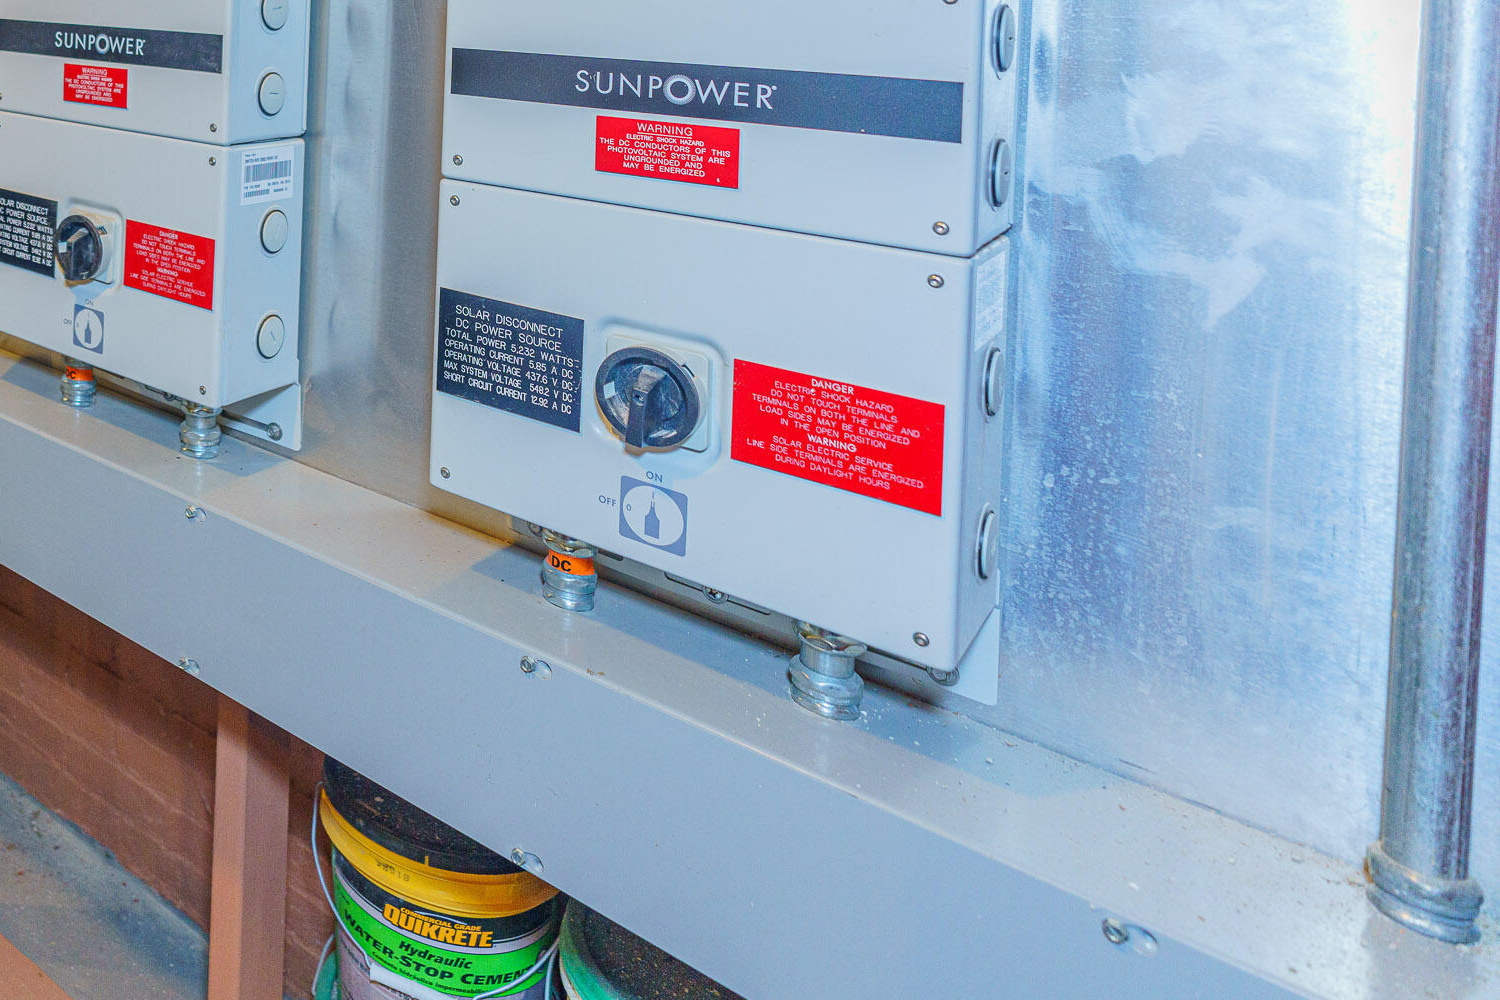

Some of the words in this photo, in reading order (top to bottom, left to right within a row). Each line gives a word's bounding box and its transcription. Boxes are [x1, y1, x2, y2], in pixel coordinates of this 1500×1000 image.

[55, 31, 145, 55] SUNPOWER
[575, 69, 775, 110] SUNPOWER
[626, 134, 653, 142] ELECTRIC
[657, 136, 677, 145] SHOCK
[637, 123, 693, 136] WARNING
[600, 137, 614, 145] THE
[619, 139, 630, 147] DC
[635, 141, 690, 154] CONDUCTORS
[711, 149, 731, 157] THIS
[607, 146, 666, 158] PHOTOVOLTAIC
[671, 152, 703, 162] SYSTEM
[708, 156, 725, 165] ARE
[624, 155, 680, 167] UNGROUNDED
[685, 162, 703, 170] AND
[659, 166, 705, 178] ENERGIZED
[6, 208, 24, 219] POWER
[455, 318, 469, 329] DC
[475, 322, 512, 340] POWER
[518, 333, 562, 352] SOURCE
[456, 305, 490, 321] SOLAR
[496, 314, 563, 338] DISCONNECT
[444, 339, 485, 356] OPERATING
[489, 350, 524, 366] CURRENT
[551, 367, 558, 375] A
[562, 368, 573, 379] DC
[445, 327, 472, 341] TOTAL
[476, 336, 506, 350] POWER
[541, 351, 573, 368] WATTS
[444, 349, 483, 366] OPERATING
[487, 360, 521, 377] VOLTAGE
[525, 371, 548, 384] 437.6
[552, 378, 558, 386] V
[562, 380, 573, 391] DC
[444, 360, 458, 370] MAX
[461, 365, 488, 379] SYSTEM
[491, 372, 522, 388] VOLTAGE
[554, 390, 559, 398] V
[562, 392, 572, 402] DC
[444, 371, 465, 384] SHORT
[468, 378, 493, 392] CIRCUIT
[496, 386, 527, 401] CURRENT
[552, 402, 558, 410] A
[562, 404, 572, 414] DC
[774, 381, 816, 395] ELECTRIC
[821, 391, 851, 403] SHOCK
[856, 399, 894, 413] HAZARD
[812, 378, 854, 395] DANGER
[752, 393, 799, 411] TERMINALS
[804, 405, 817, 414] ON
[821, 408, 845, 421] BOTH
[851, 415, 868, 426] THE
[874, 421, 894, 432] LINE
[901, 427, 920, 438] AND
[770, 389, 783, 397] DO
[787, 392, 804, 402] NOT
[811, 397, 840, 411] TOUCH
[846, 405, 898, 424] TERMINALS
[760, 404, 783, 416] LOAD
[788, 411, 813, 424] SIDES
[817, 417, 836, 429] MAY
[842, 423, 853, 432] BE
[859, 427, 910, 445] ENERGIZED
[794, 421, 810, 431] THE
[815, 426, 839, 438] OPEN
[844, 432, 886, 449] POSITION
[773, 436, 802, 448] SOLAR
[807, 444, 849, 461] ELECTRIC
[855, 456, 893, 472] SERVICE
[808, 434, 857, 452] WARNING
[646, 471, 663, 483] ON
[746, 438, 765, 449] LINE
[770, 444, 788, 455] SIDE
[794, 449, 843, 469] TERMINALS
[849, 464, 867, 475] ARE
[872, 469, 924, 489] ENERGIZED
[775, 454, 805, 469] DURING
[810, 462, 853, 480] DAYLIGHT
[859, 474, 890, 489] HOURS
[598, 495, 617, 507] OFF
[551, 555, 571, 572] DC
[383, 903, 493, 947] QUIKRETE
[401, 907, 452, 928] COMMERCIAL
[454, 923, 482, 931] GRADE
[345, 909, 454, 980] WATER-STOP
[399, 942, 473, 969] Hydraulic
